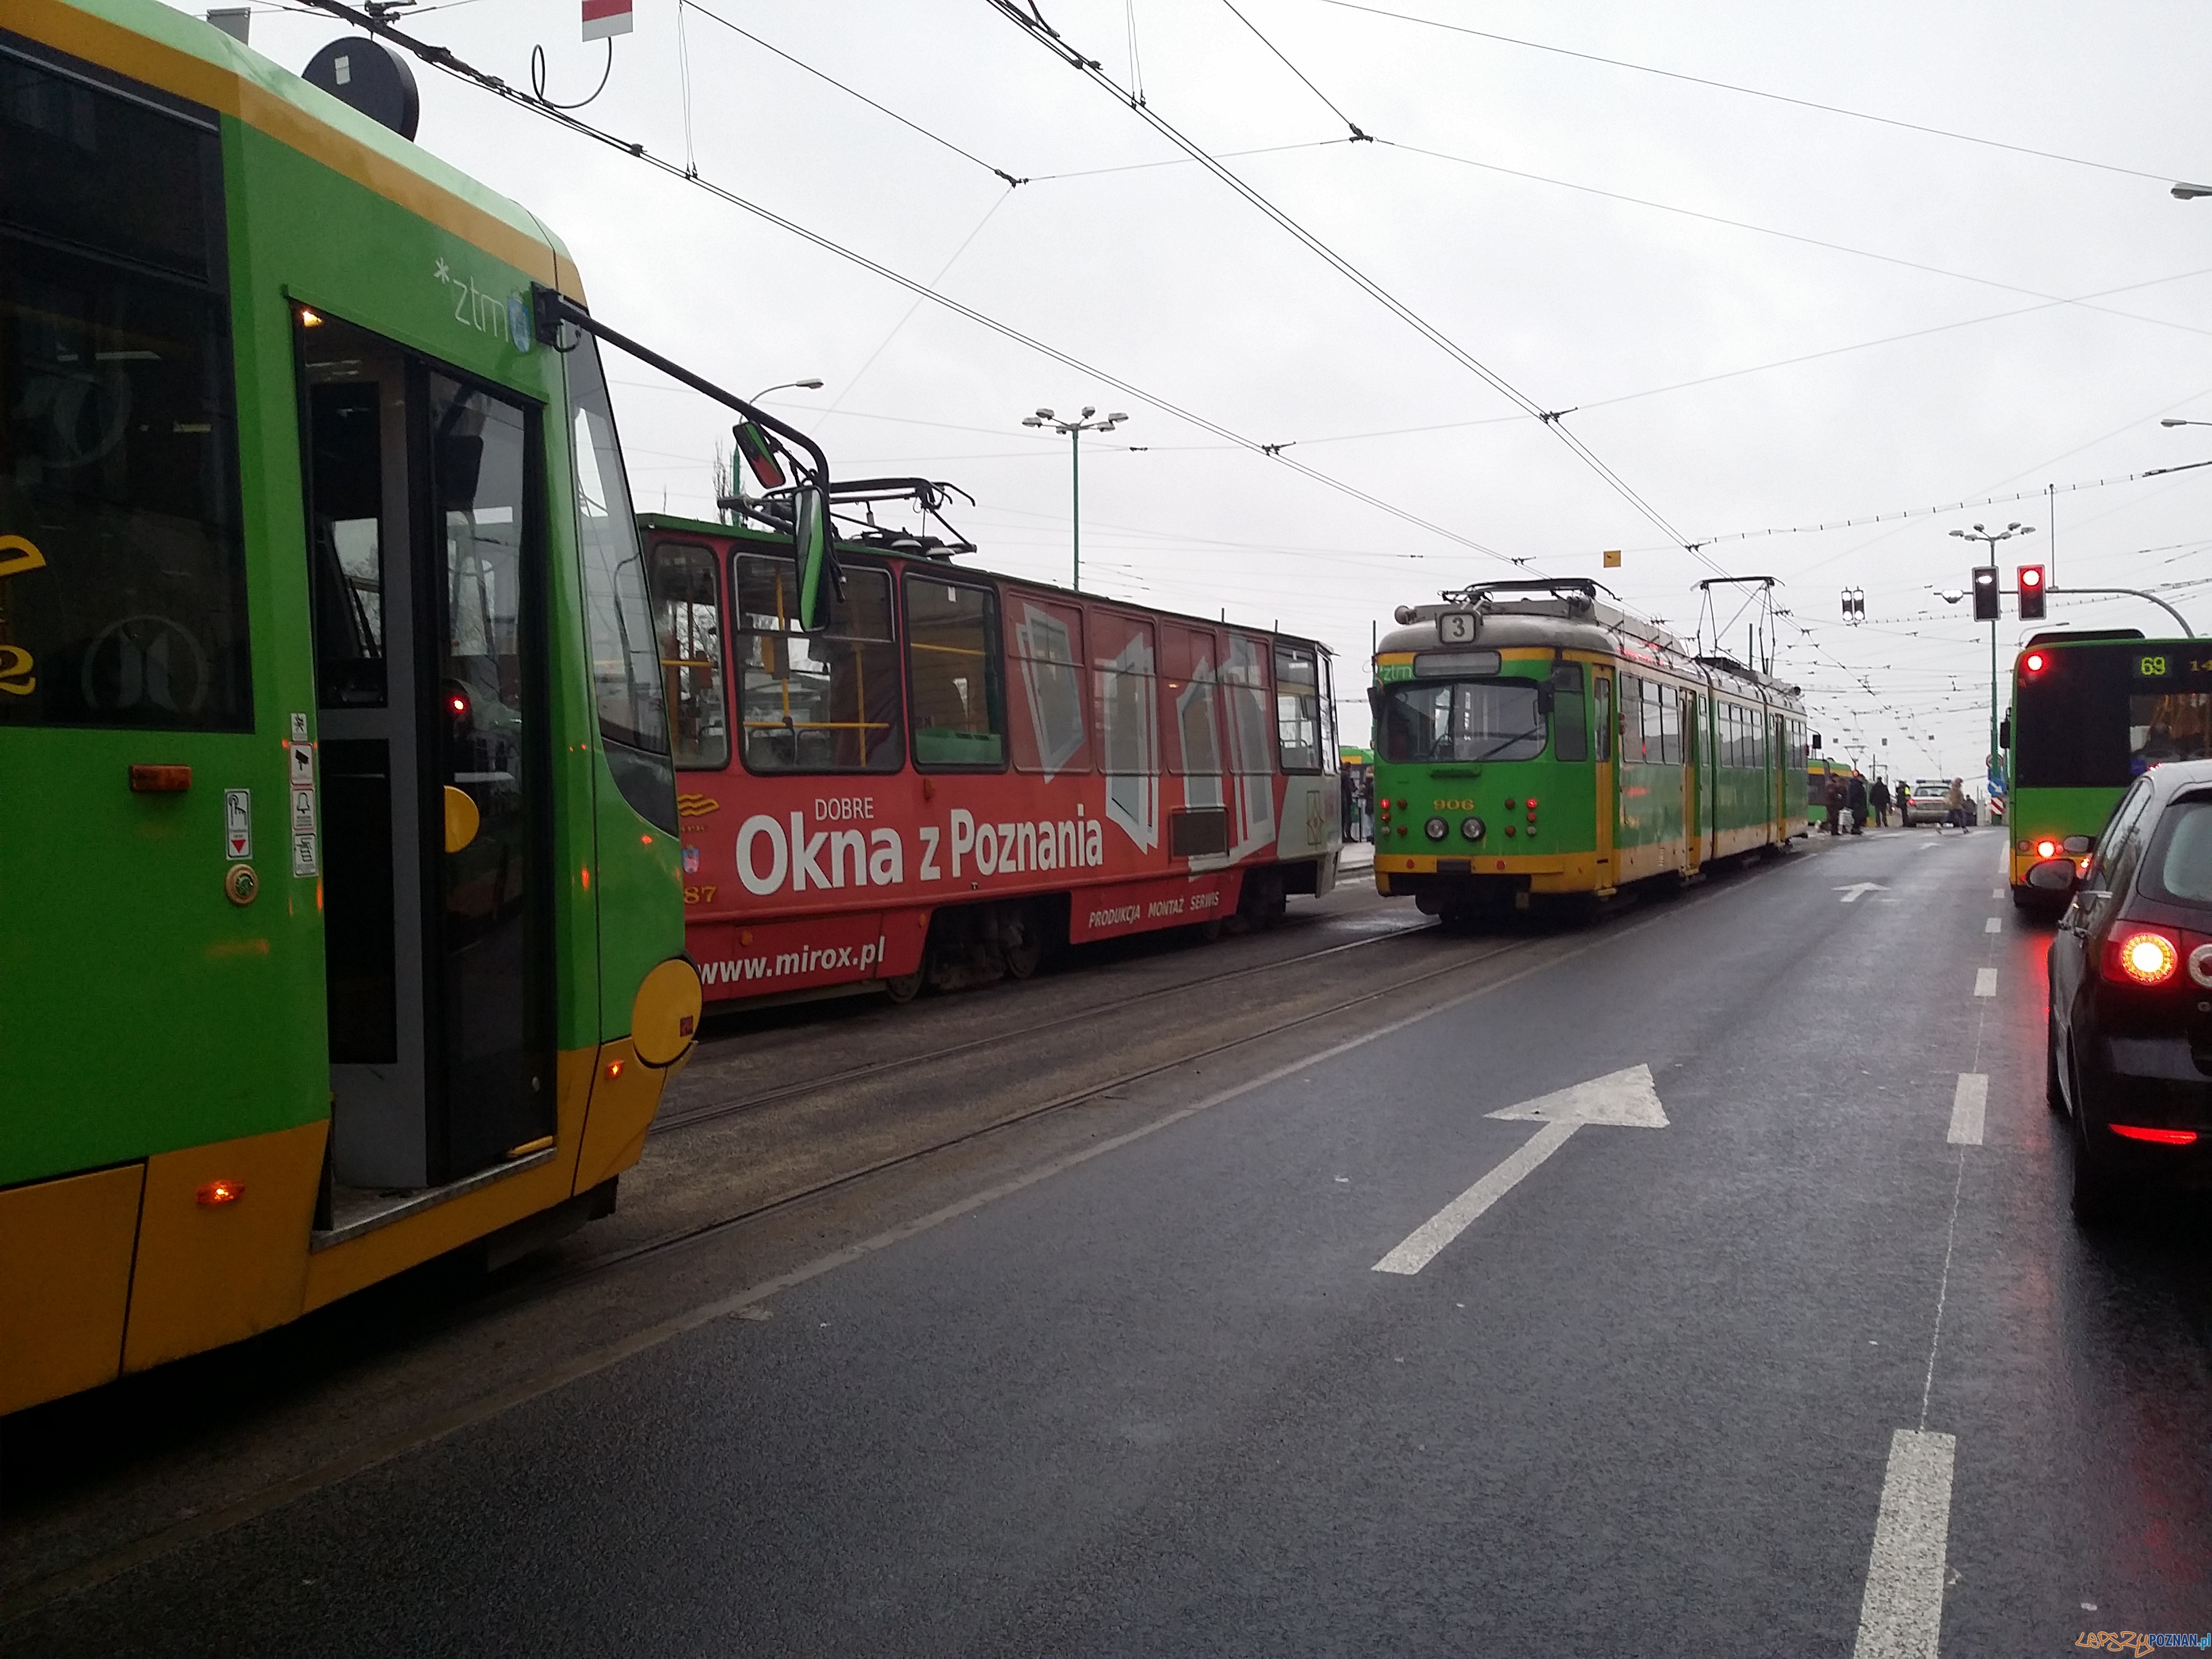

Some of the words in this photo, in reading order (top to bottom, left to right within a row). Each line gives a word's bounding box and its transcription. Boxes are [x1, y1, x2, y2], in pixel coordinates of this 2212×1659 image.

[1452, 617, 1465, 637] 3
[2141, 657, 2166, 675] 69
[815, 797, 874, 821] DOBRE
[1433, 799, 1474, 811] 906
[736, 811, 903, 895] Okna
[920, 826, 941, 880] z
[951, 803, 1103, 878] Poznania
[1088, 904, 1141, 928] PRODUKCJA
[1147, 895, 1185, 918] MONTAŻ
[1189, 891, 1219, 910] SERWIS
[697, 935, 885, 984] www.mirox.pl
